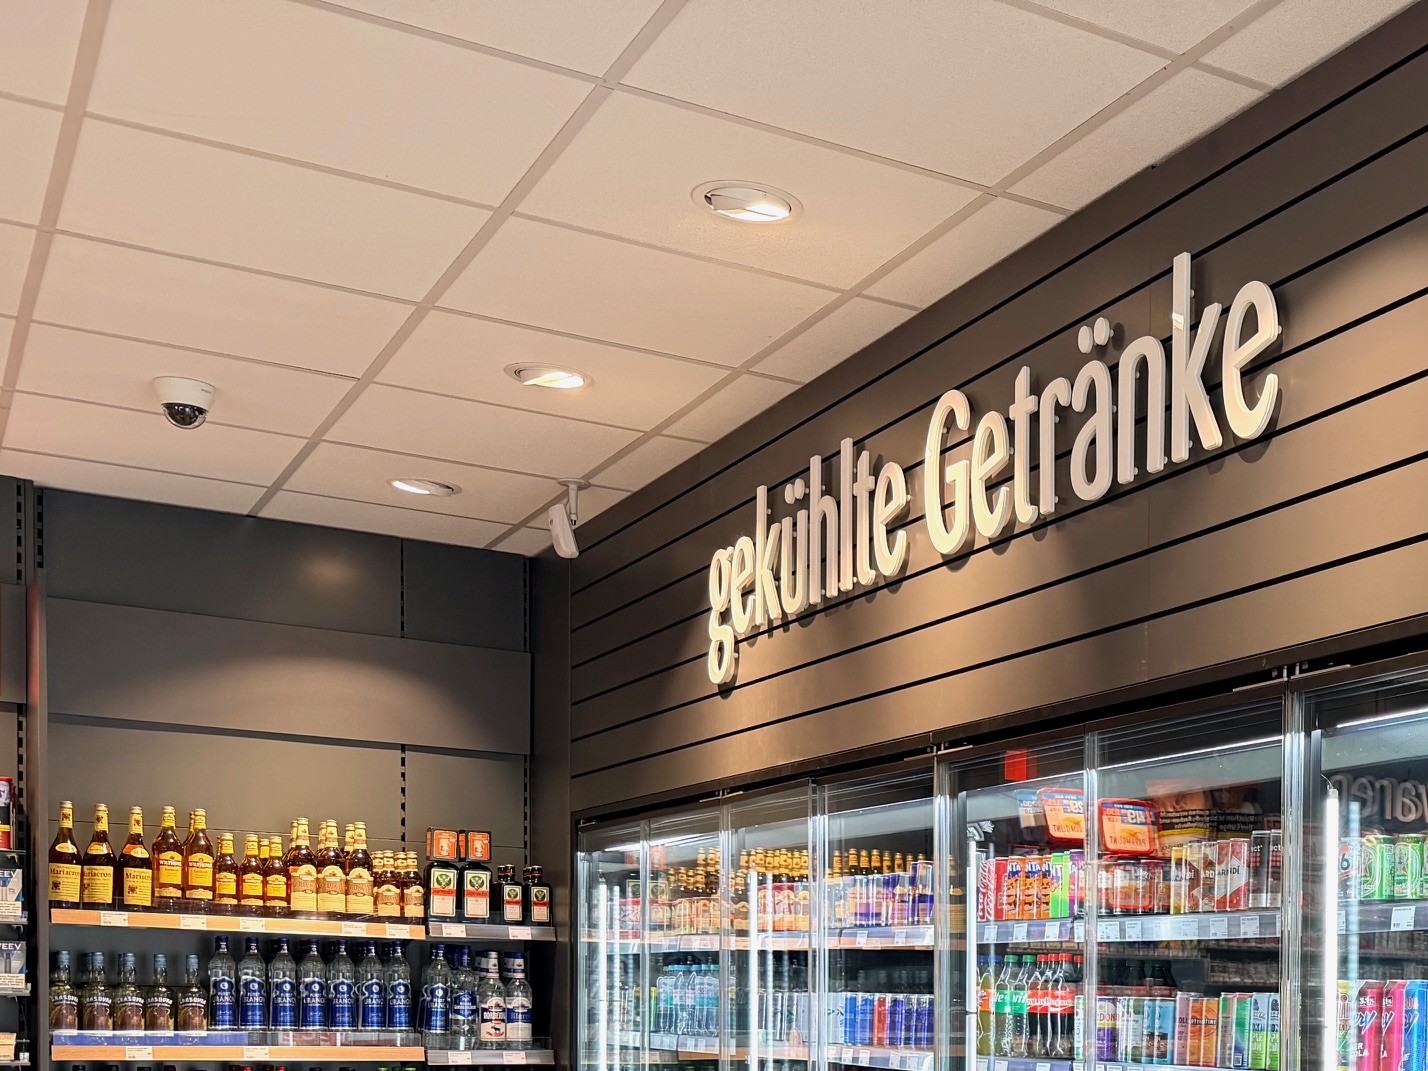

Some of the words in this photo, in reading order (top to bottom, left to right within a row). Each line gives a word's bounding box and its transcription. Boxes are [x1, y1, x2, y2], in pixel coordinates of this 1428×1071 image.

[708, 437, 908, 684] gekühlte
[925, 252, 1279, 554] Getränke
[83, 868, 114, 880] ariacron
